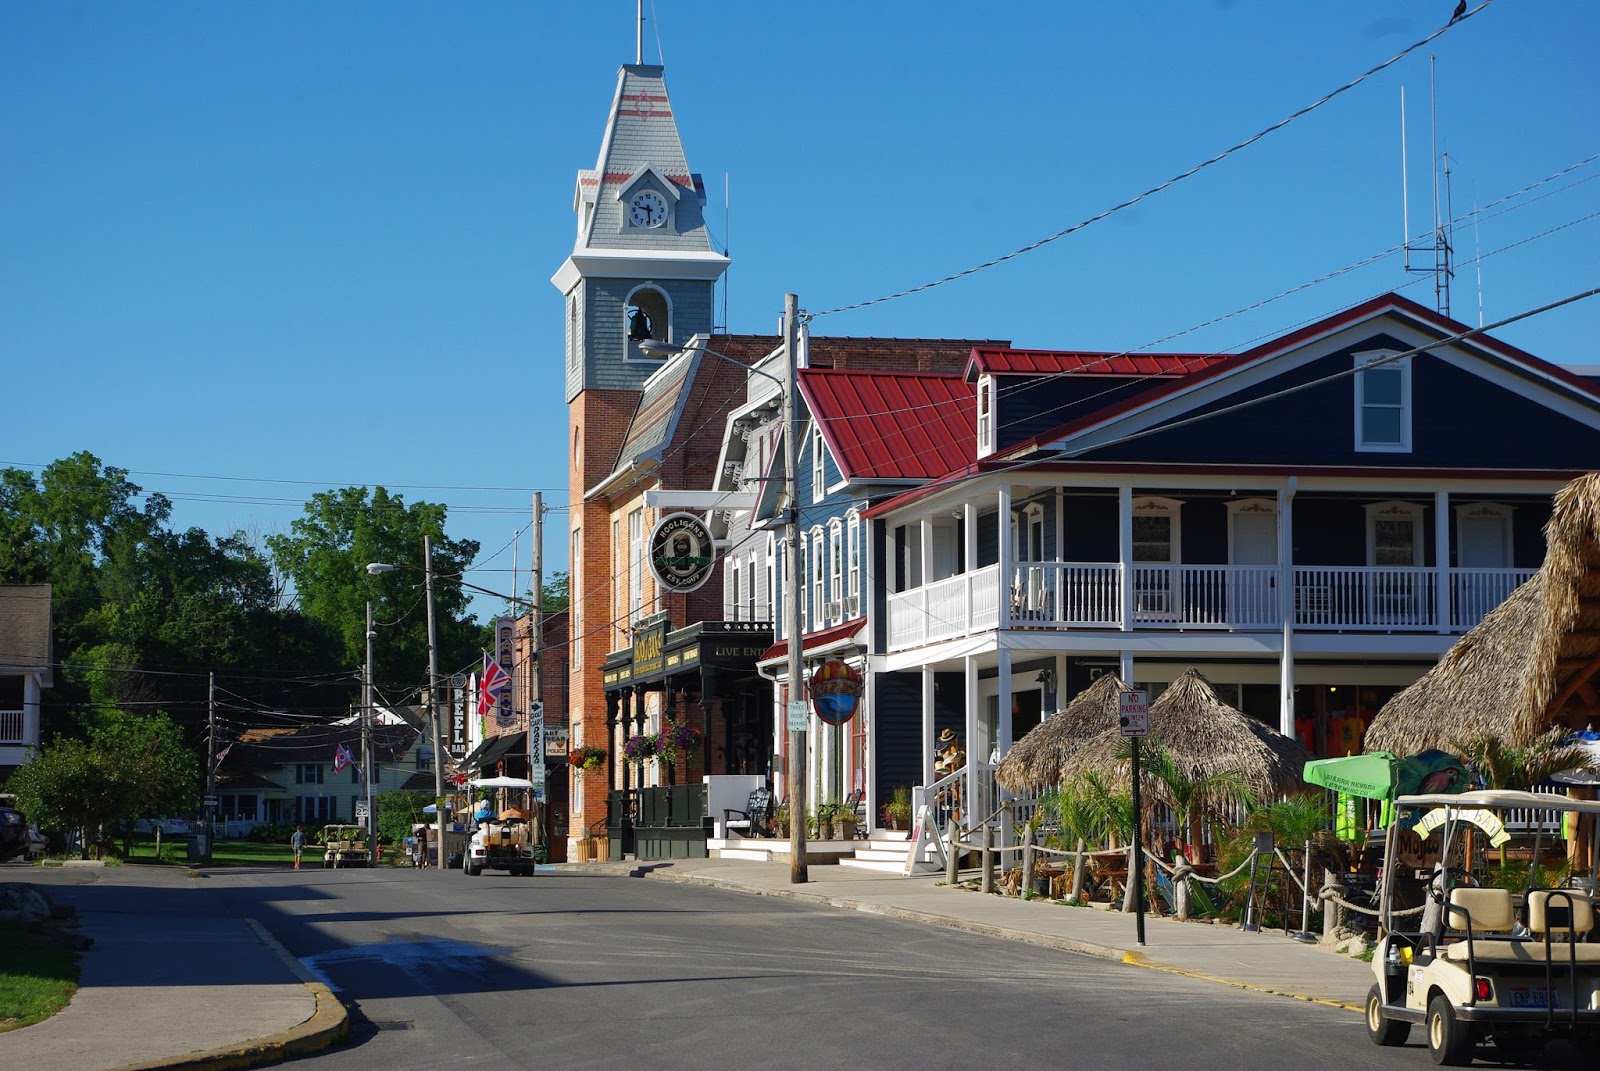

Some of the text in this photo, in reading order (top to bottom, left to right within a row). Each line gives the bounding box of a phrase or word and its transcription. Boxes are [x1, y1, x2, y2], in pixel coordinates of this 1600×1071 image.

[660, 520, 704, 538] HOOLIGANS
[716, 646, 740, 656] LIVE
[1128, 694, 1139, 703] NO
[530, 710, 542, 719] GOLF
[1121, 705, 1146, 713] PARKING
[453, 689, 464, 743] REEL
[530, 719, 542, 728] CART
[451, 745, 466, 753] BAR
[1326, 774, 1376, 791] SIERRA NEVADA
[1328, 782, 1359, 794] BREWING
[1474, 809, 1497, 833] BAY
[1514, 992, 1531, 1004] EKP
